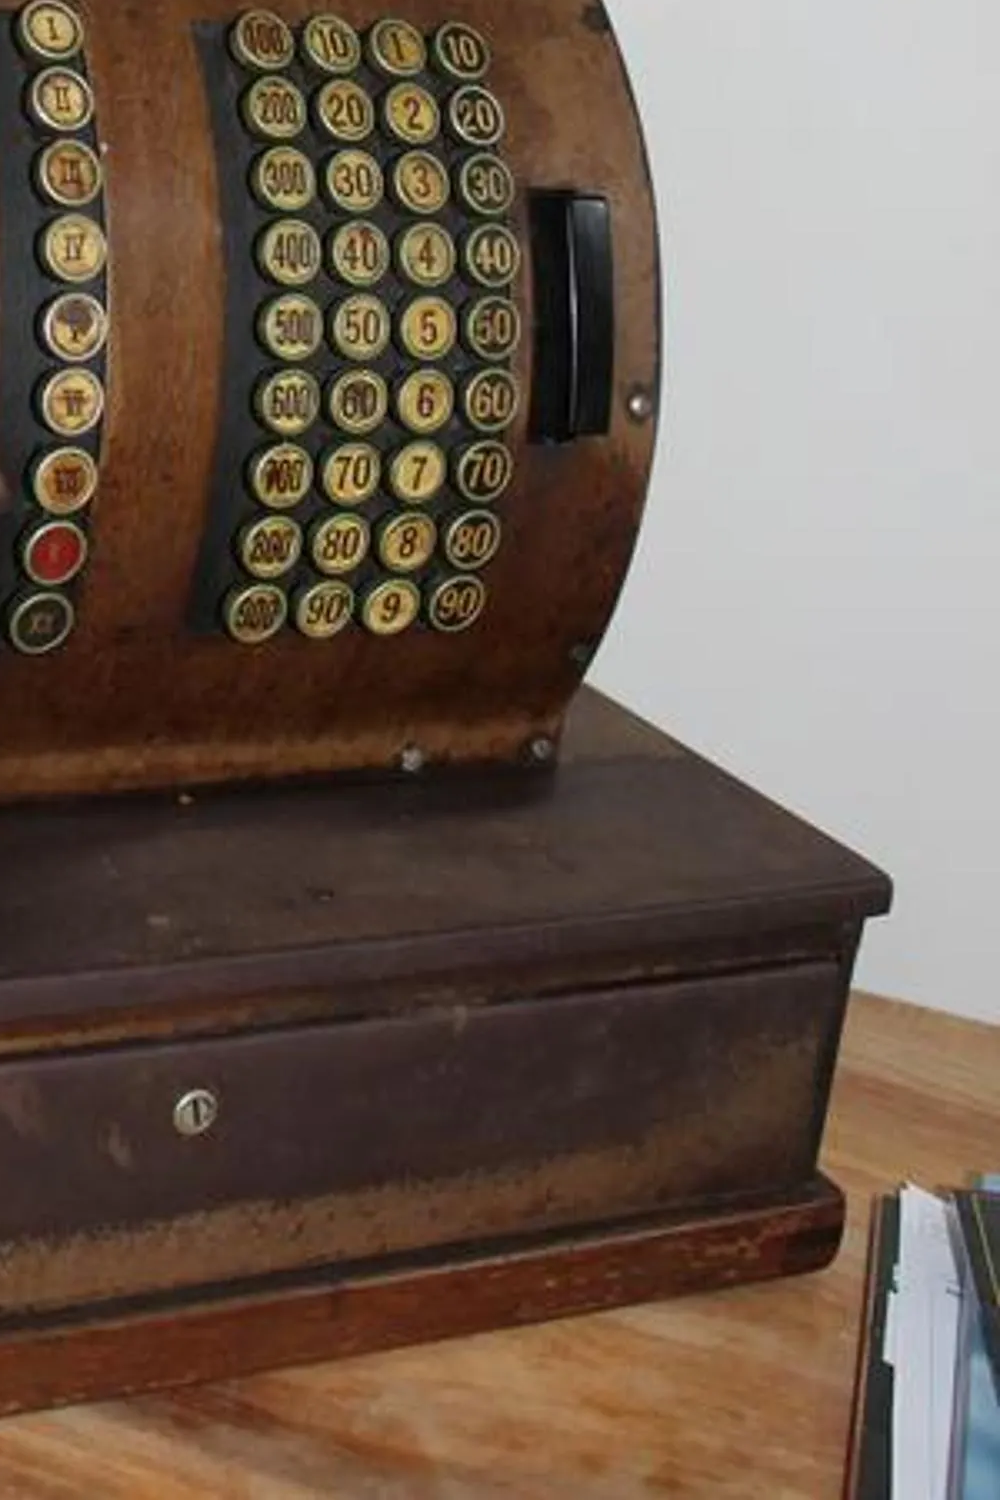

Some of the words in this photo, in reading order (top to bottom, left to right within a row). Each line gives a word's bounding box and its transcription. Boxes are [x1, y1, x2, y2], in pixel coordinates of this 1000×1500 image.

[316, 26, 348, 59] 10
[390, 32, 407, 62] 1
[446, 34, 478, 68] 10
[258, 88, 297, 124] 200
[327, 94, 365, 127] 20
[402, 100, 424, 131] 2
[459, 99, 495, 133] 20
[265, 159, 304, 197] 300
[334, 162, 374, 198] 30
[411, 162, 432, 198] 3
[472, 167, 505, 201] 30
[272, 232, 311, 272] 400
[341, 231, 379, 272] 40
[417, 237, 437, 271] 4
[475, 235, 509, 273] 40
[274, 308, 316, 346] 500
[345, 308, 382, 345] 50
[420, 310, 438, 347] 5
[477, 308, 512, 345] 50
[341, 381, 378, 420] 60
[416, 383, 436, 418] 6
[475, 382, 511, 420] 60
[334, 455, 371, 491] 70
[411, 455, 429, 491] 7
[468, 451, 501, 489] 70
[322, 526, 362, 561] 80
[399, 526, 419, 559] 8
[453, 524, 491, 558] 80
[305, 594, 345, 626] 90
[381, 592, 402, 624] 9
[437, 588, 477, 621] 90
